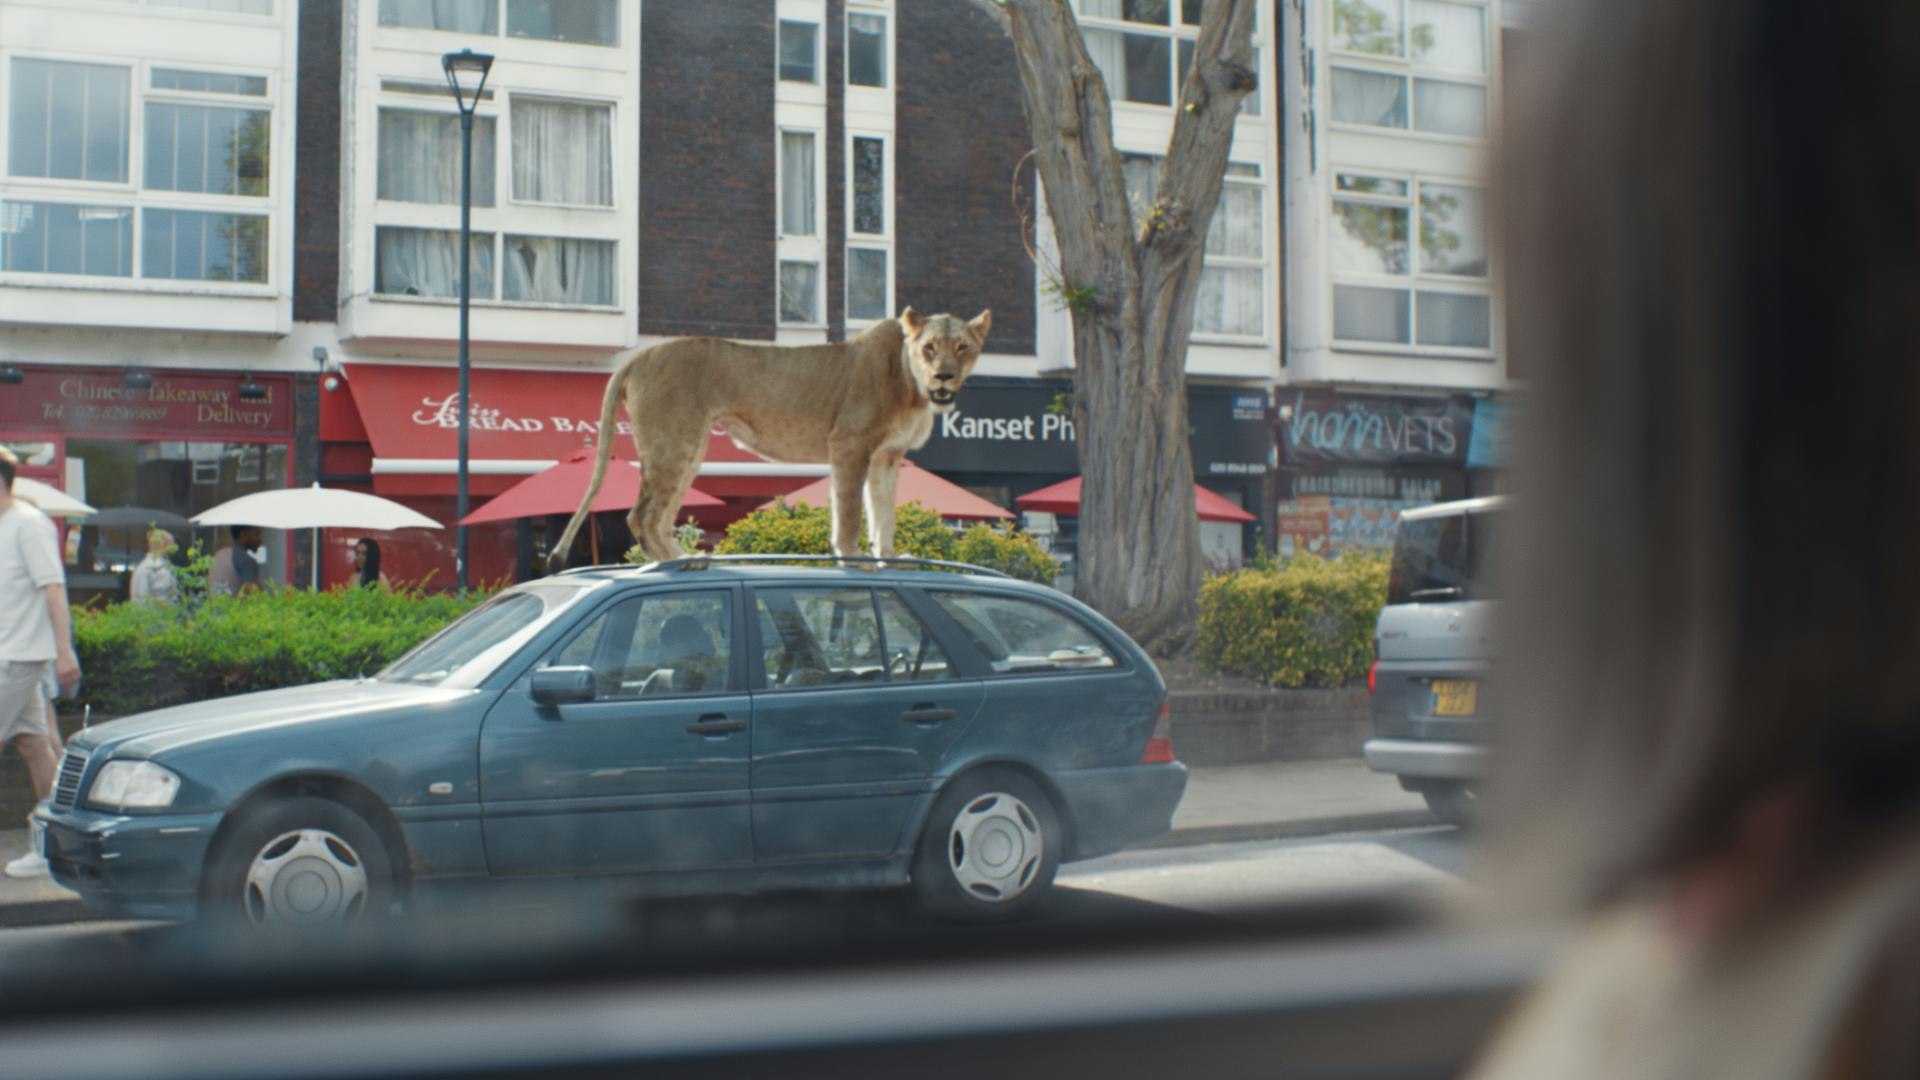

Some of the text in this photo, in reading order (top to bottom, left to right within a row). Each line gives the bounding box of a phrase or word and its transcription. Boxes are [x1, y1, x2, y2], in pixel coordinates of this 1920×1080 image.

[59, 378, 136, 402] Chinese
[149, 382, 231, 405] Takeaway
[197, 404, 273, 427] Delivery
[942, 411, 1076, 442] Kanset Ph
